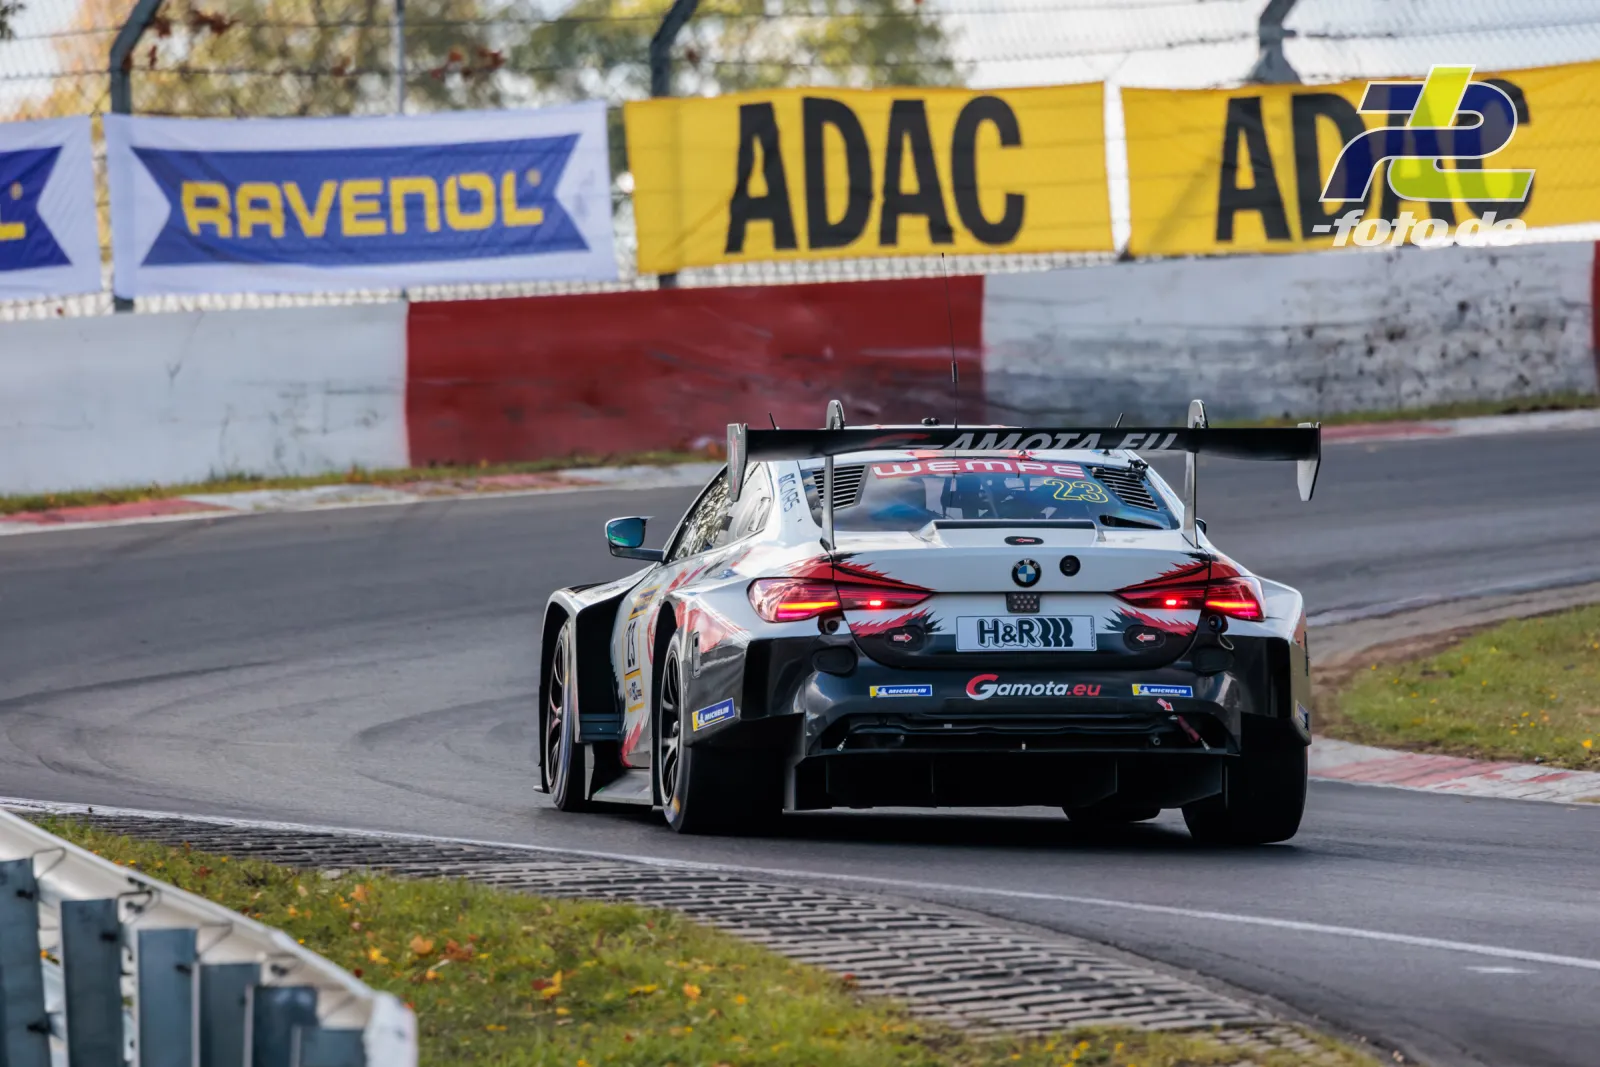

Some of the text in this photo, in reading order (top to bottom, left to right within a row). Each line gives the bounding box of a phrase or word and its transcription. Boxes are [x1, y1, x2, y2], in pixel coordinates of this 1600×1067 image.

[724, 95, 1026, 255] ADAC
[181, 171, 545, 239] RAVENOL
[872, 461, 1086, 478] WEMPE
[1043, 478, 1109, 504] 23
[977, 618, 1040, 648] H&R
[966, 673, 1101, 701] Gamota.eu
[704, 706, 729, 721] MICHELIN
